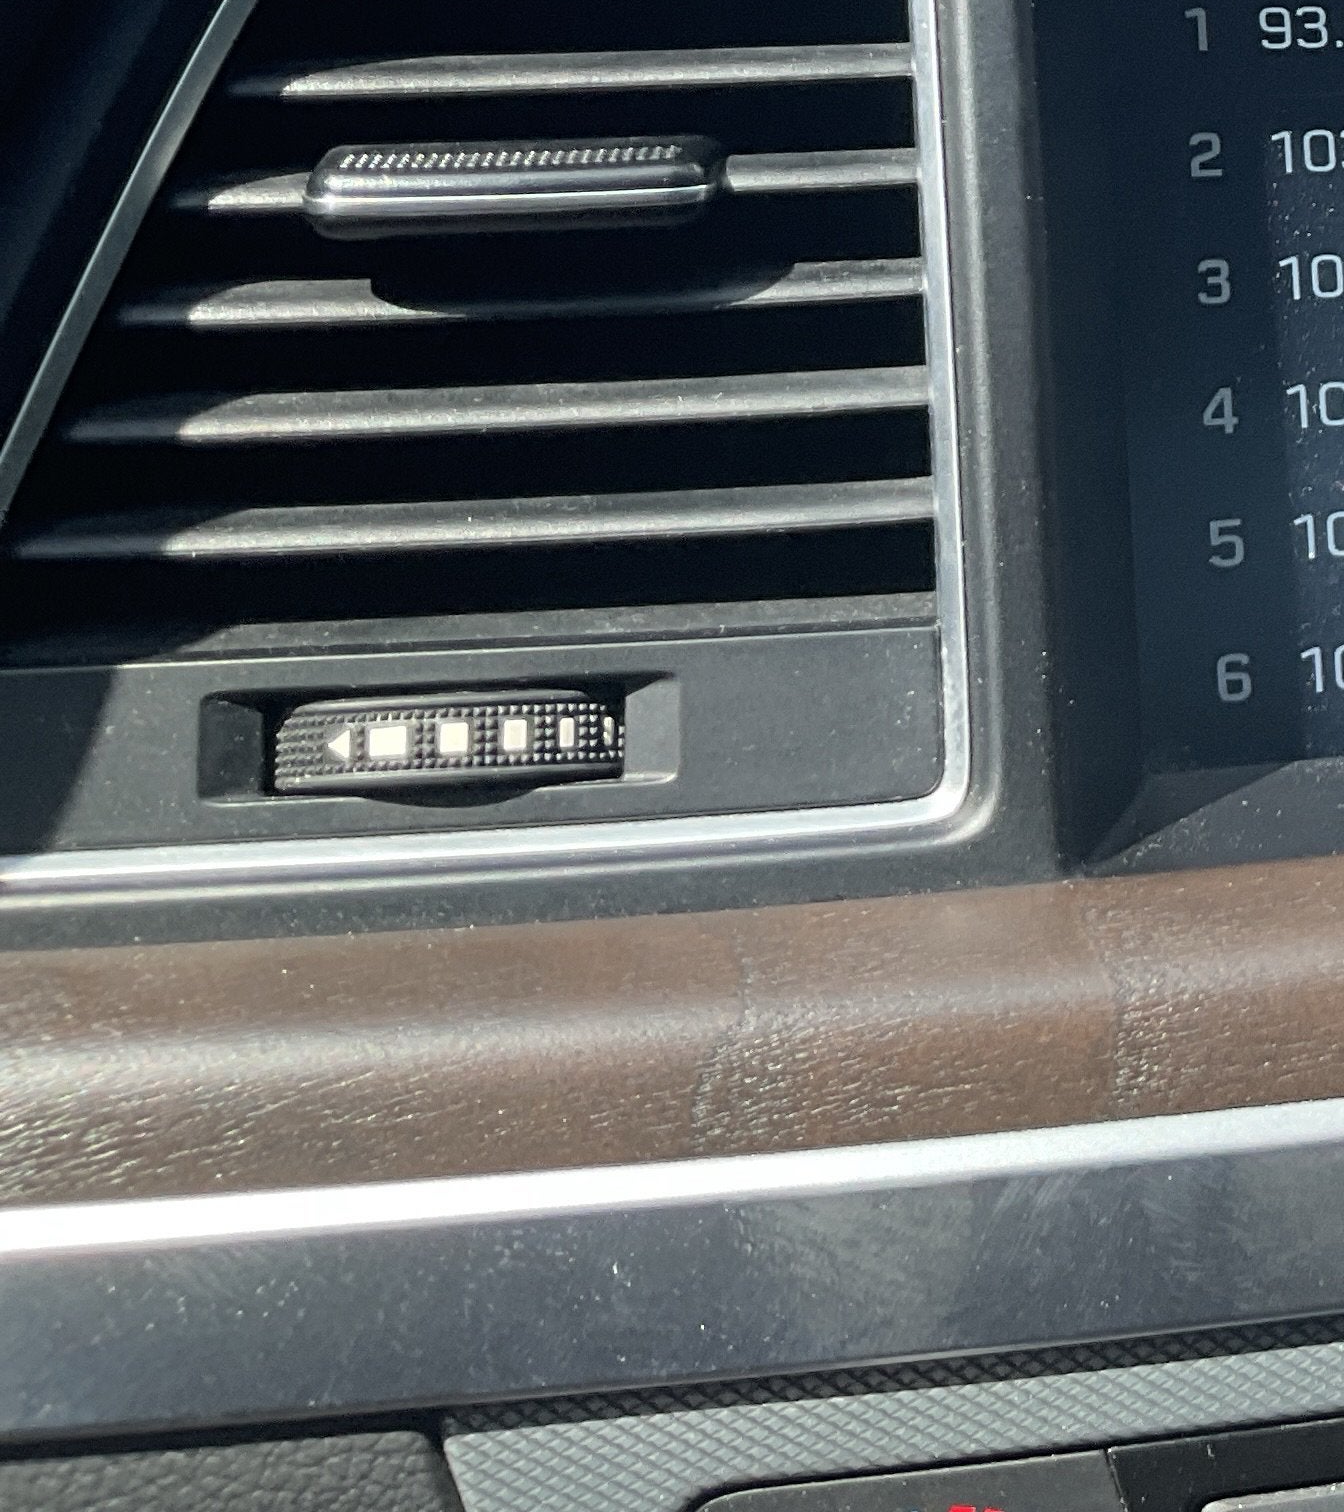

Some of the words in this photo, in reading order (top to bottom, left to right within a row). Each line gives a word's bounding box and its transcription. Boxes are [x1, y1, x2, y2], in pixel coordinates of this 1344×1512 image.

[1184, 9, 1209, 50] 1
[1189, 134, 1222, 177] 2
[1198, 260, 1231, 304] 3
[1204, 389, 1239, 433] 4
[1209, 520, 1244, 567] 5
[1216, 656, 1251, 702] 6
